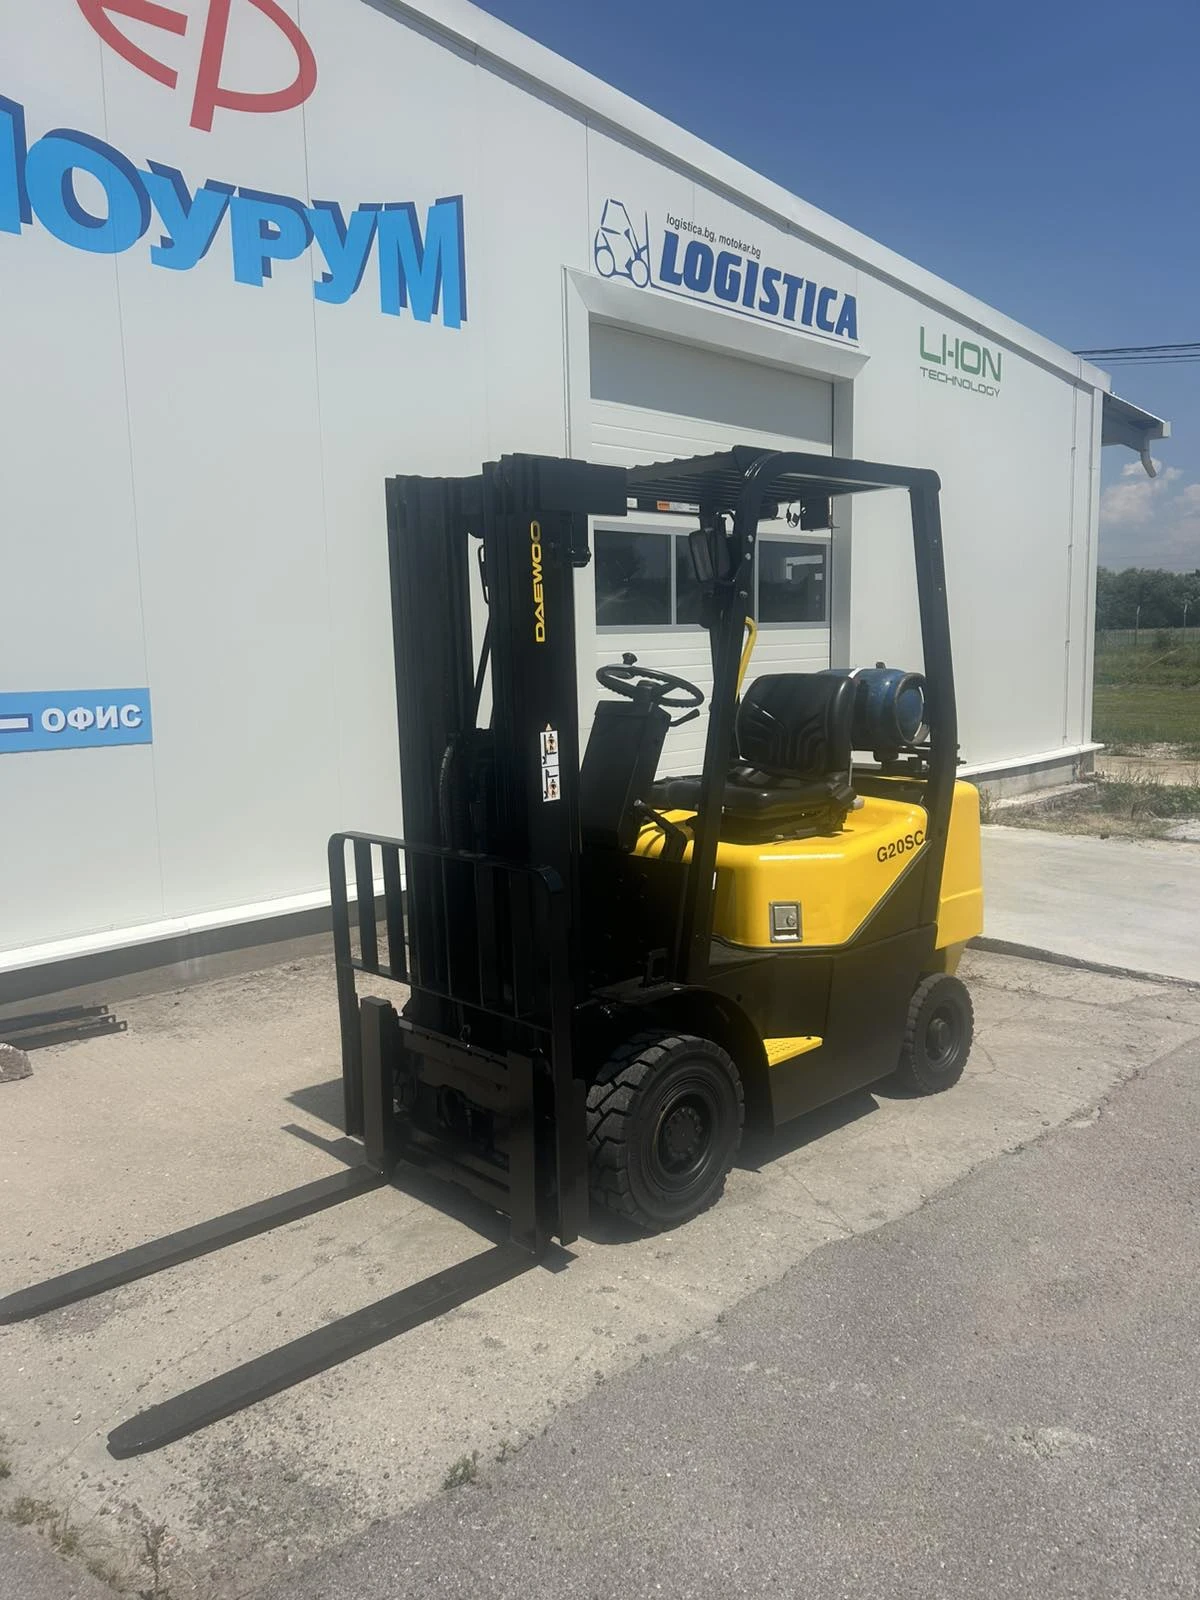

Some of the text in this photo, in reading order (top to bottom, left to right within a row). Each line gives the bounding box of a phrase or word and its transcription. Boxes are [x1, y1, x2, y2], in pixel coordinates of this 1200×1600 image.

[666, 212, 762, 260] logistica.bg, motokar.bg
[659, 230, 858, 341] LOGISTICA
[920, 326, 1002, 382] LI-ION
[920, 366, 1001, 398] TECHNOLOGY
[530, 520, 545, 642] DAEWOO
[41, 704, 143, 733] ОФИС
[876, 830, 924, 862] G20SC
